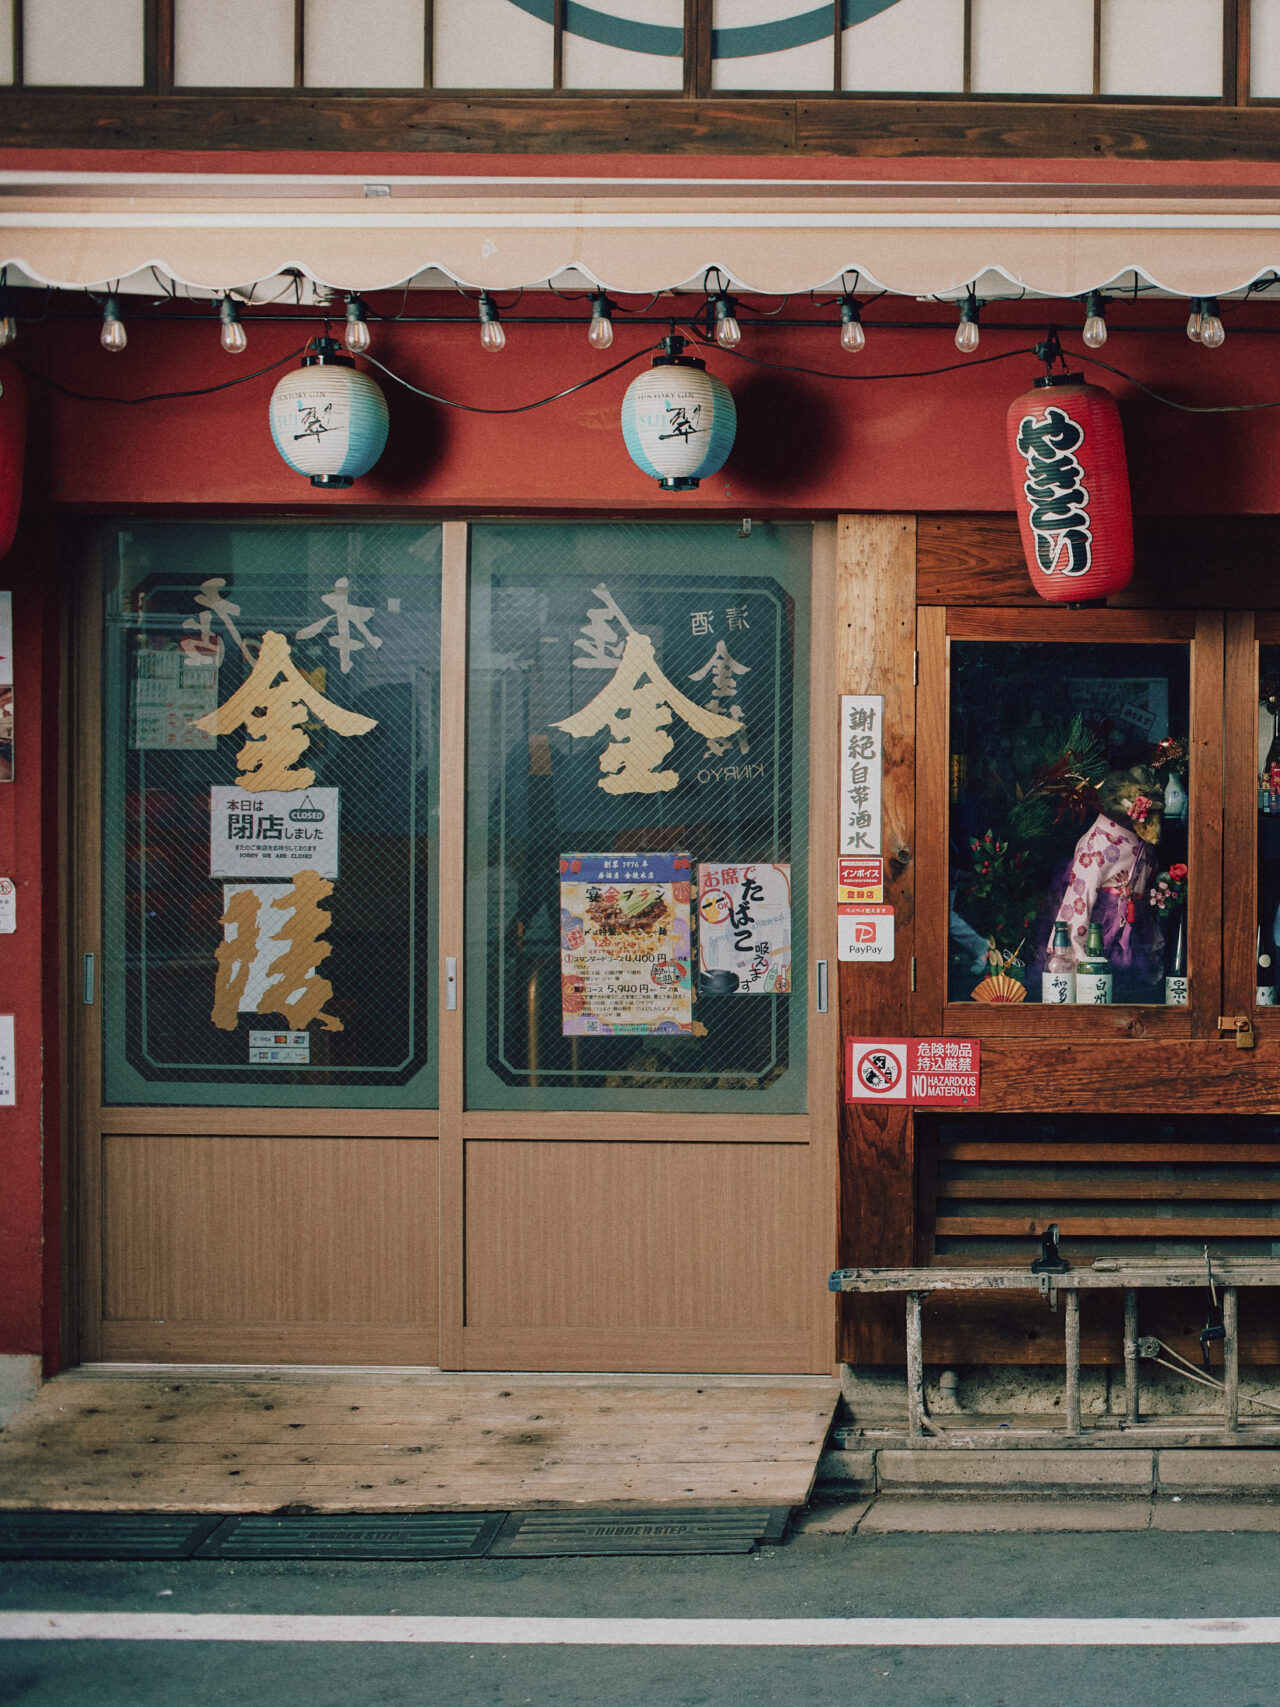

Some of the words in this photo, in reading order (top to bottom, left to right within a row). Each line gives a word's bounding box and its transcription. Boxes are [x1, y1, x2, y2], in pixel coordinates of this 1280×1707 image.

[1016, 406, 1093, 577] やきとり
[227, 800, 264, 812] 本日は
[291, 811, 323, 820] CLOSED
[227, 813, 324, 840] 閉店しました
[622, 860, 639, 868] 1976
[703, 865, 757, 888] お席で
[841, 869, 880, 878] インボイス
[585, 885, 665, 902] 宴会プラン
[847, 890, 874, 899] 登録店
[717, 902, 729, 910] OK
[728, 878, 765, 952] たばこ
[849, 945, 883, 955] PayPay
[625, 953, 667, 963] 4,400円
[741, 942, 770, 992] 吸えます
[607, 984, 649, 993] 5,940円
[1094, 978, 1107, 1004] 白州
[1170, 980, 1187, 1005] 景
[917, 1042, 972, 1057] 危険物品
[917, 1058, 972, 1072] 持込厳禁
[911, 1074, 927, 1097] NO
[927, 1076, 976, 1086] HAZARDOUS
[927, 1086, 976, 1097] MATERIALS
